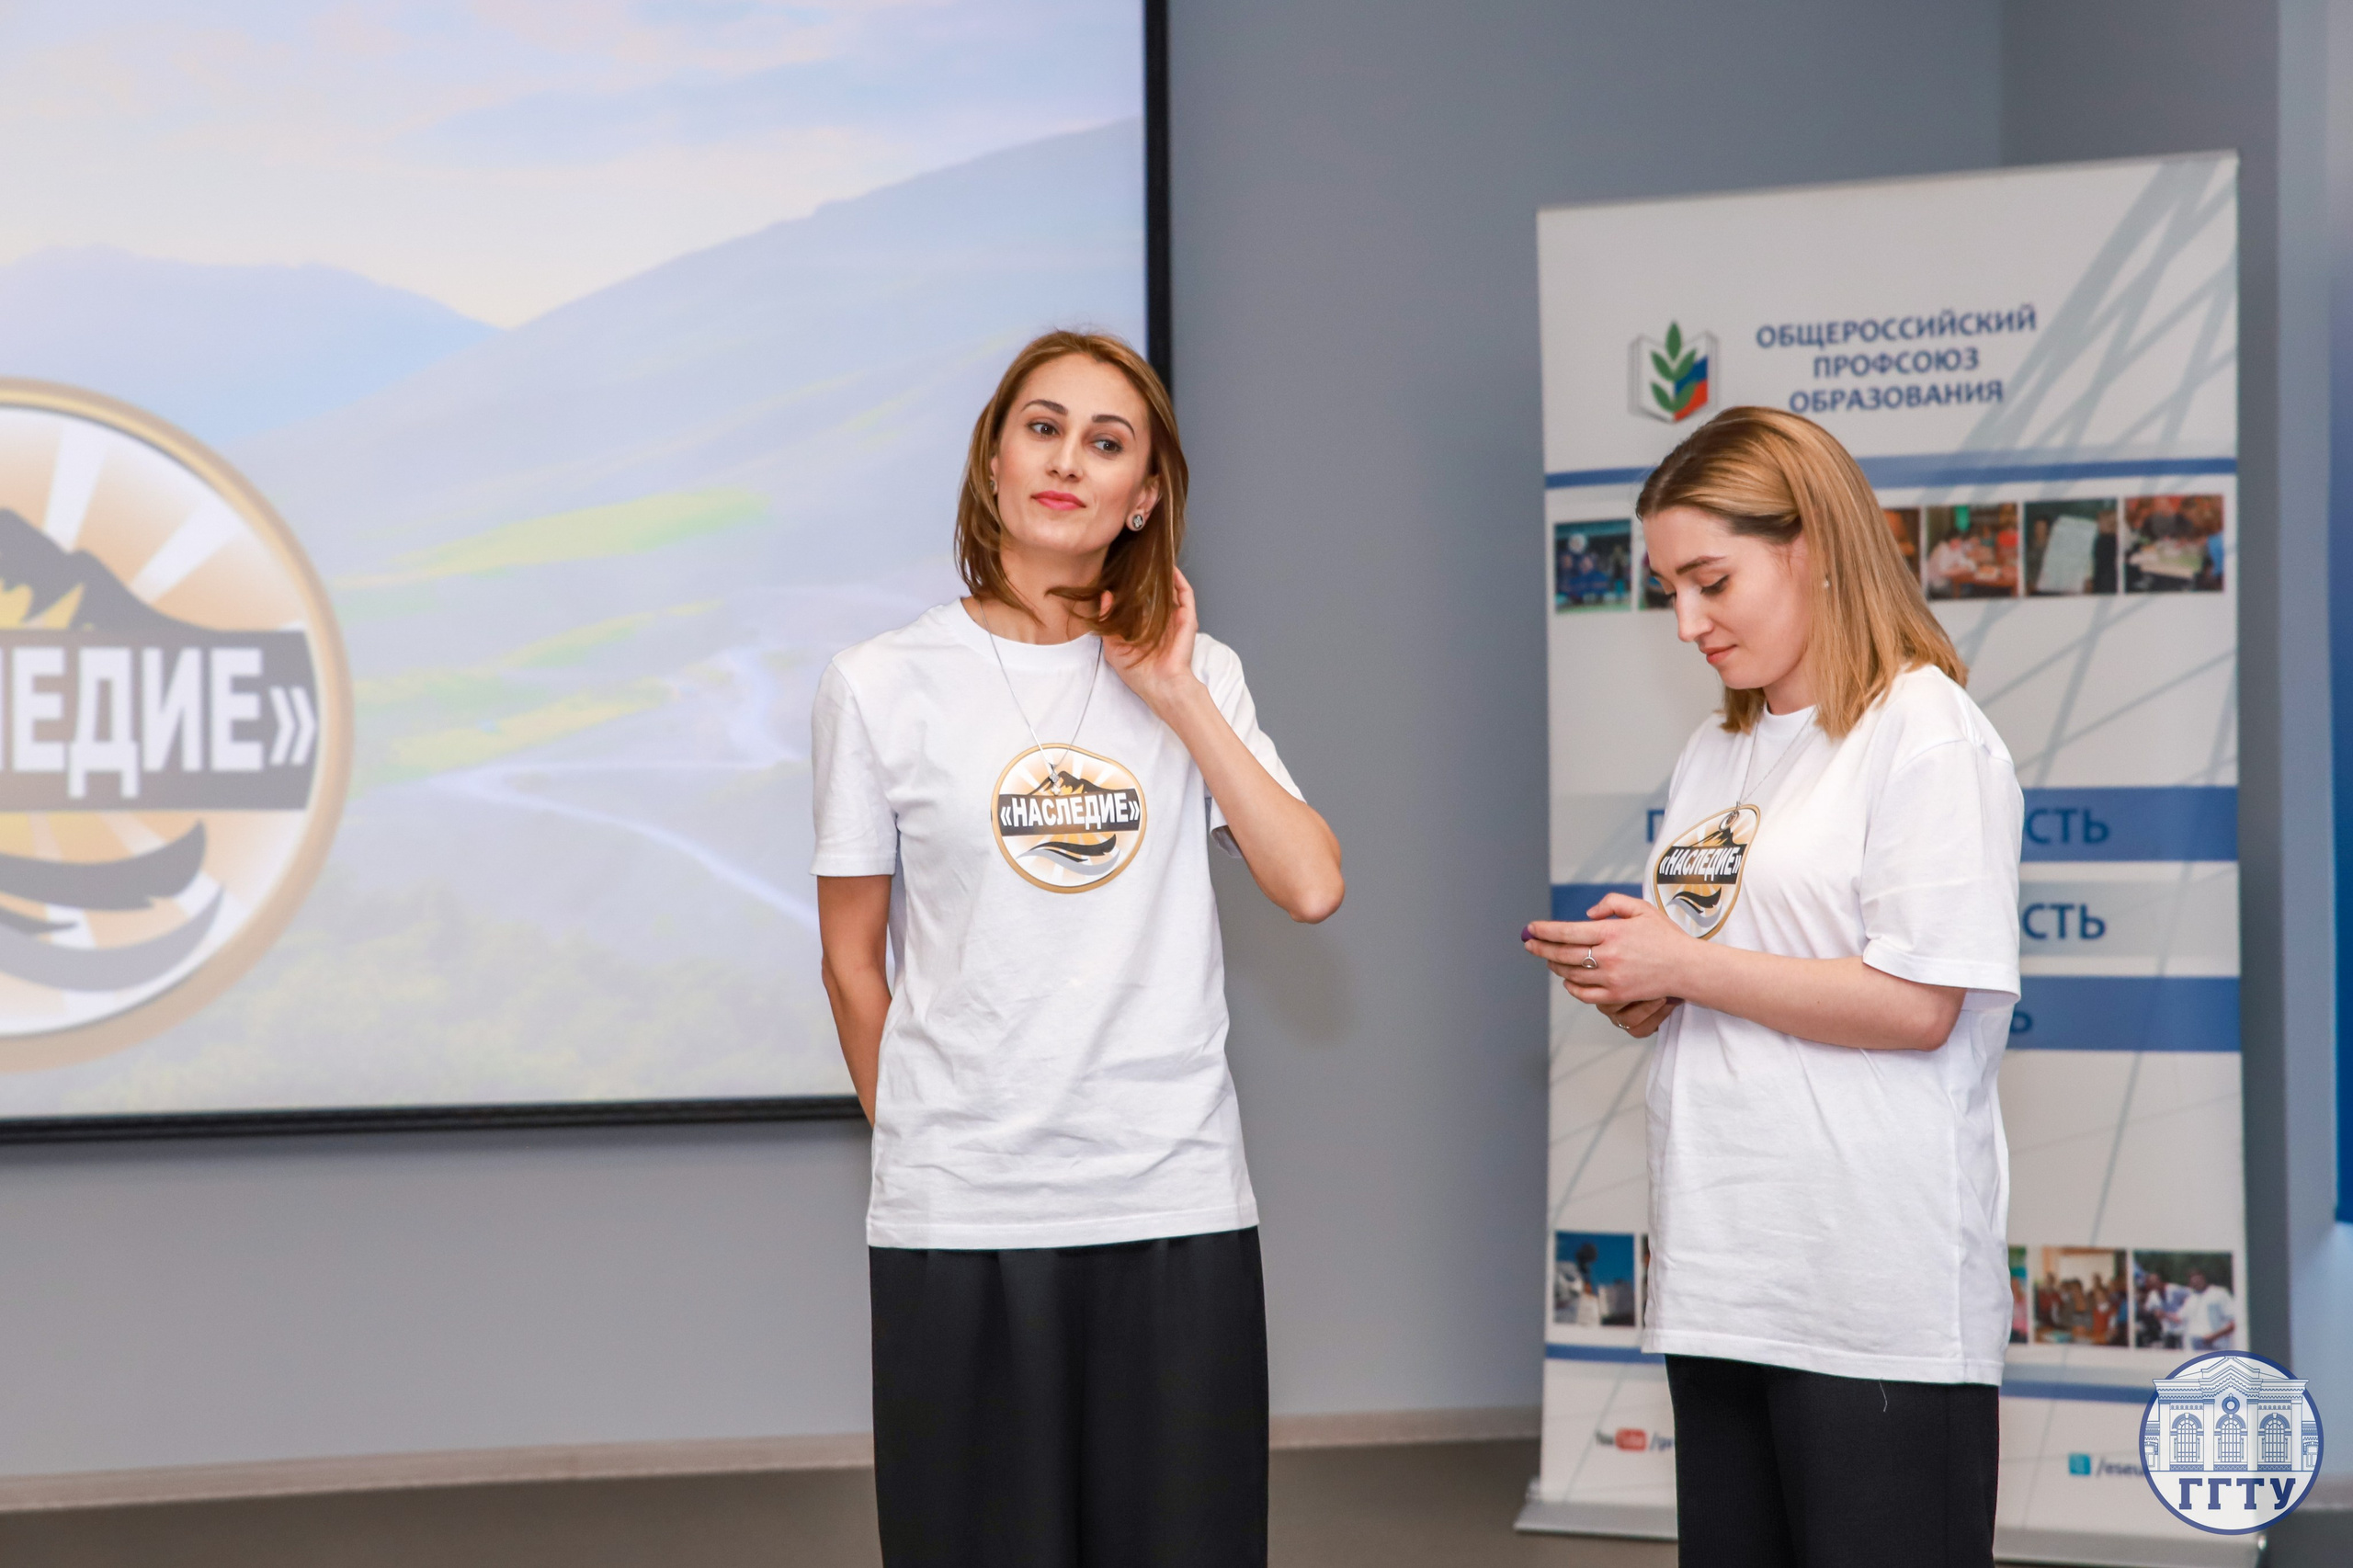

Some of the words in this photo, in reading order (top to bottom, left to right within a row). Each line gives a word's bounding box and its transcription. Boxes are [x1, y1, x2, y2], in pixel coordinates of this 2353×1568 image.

[1756, 304, 2037, 349] ОБЩЕРОССИЙСКИЙ
[1813, 347, 1979, 379] ПРОФСОЮЗ
[1790, 380, 2003, 414] ОБРАЗОВАНИЯ
[0, 646, 317, 800] ЕДИЕ»
[1000, 792, 1141, 830] «НАСЛЕДИЕ»
[1659, 846, 1742, 881] «НАСЛЕДИЕ»
